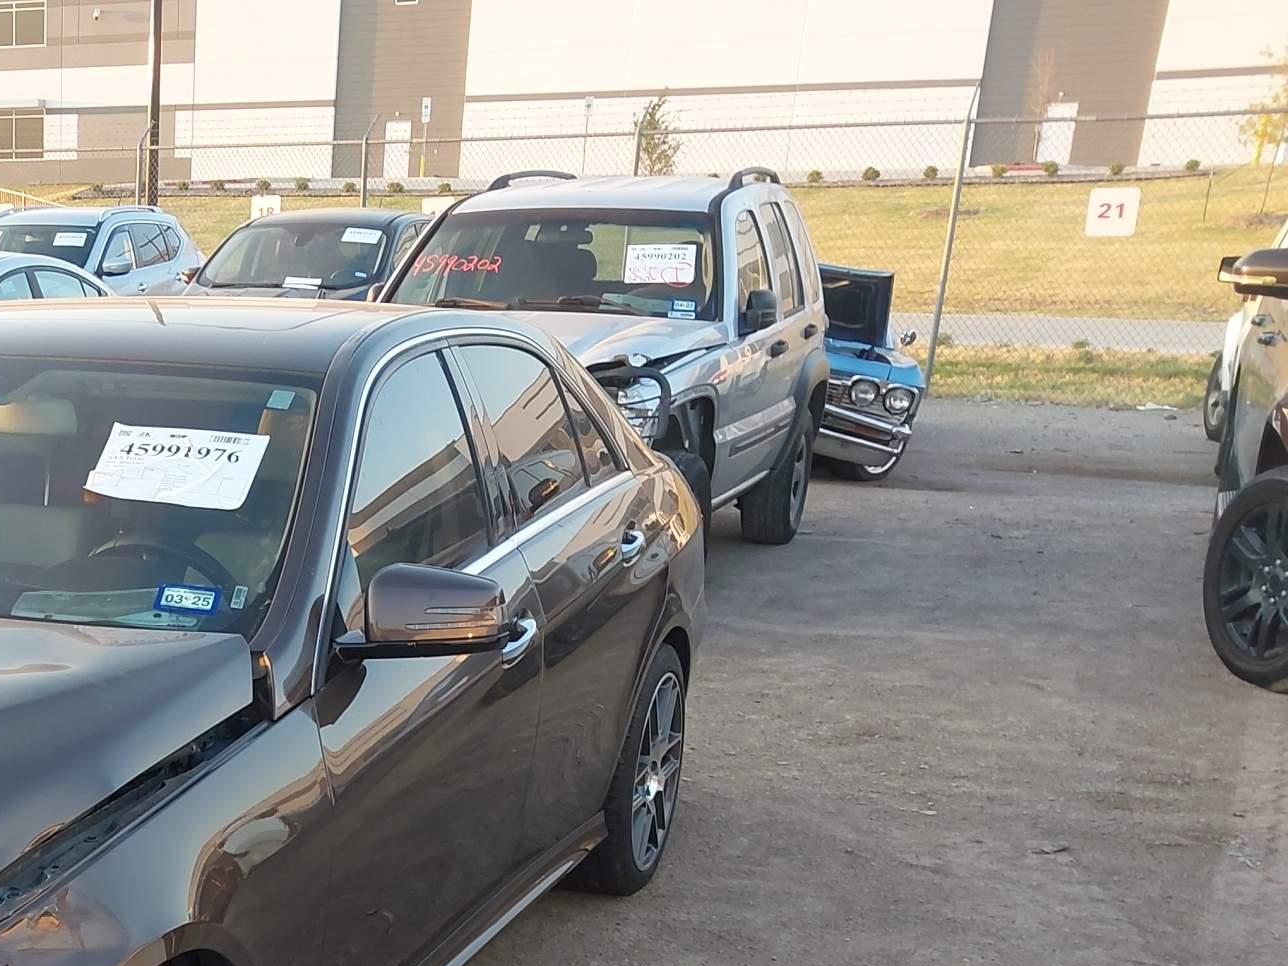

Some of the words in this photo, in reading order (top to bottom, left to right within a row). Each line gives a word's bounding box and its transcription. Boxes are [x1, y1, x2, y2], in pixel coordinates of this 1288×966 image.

[1097, 202, 1125, 219] 21
[634, 252, 687, 261] 45990202
[120, 442, 244, 464] 45991976
